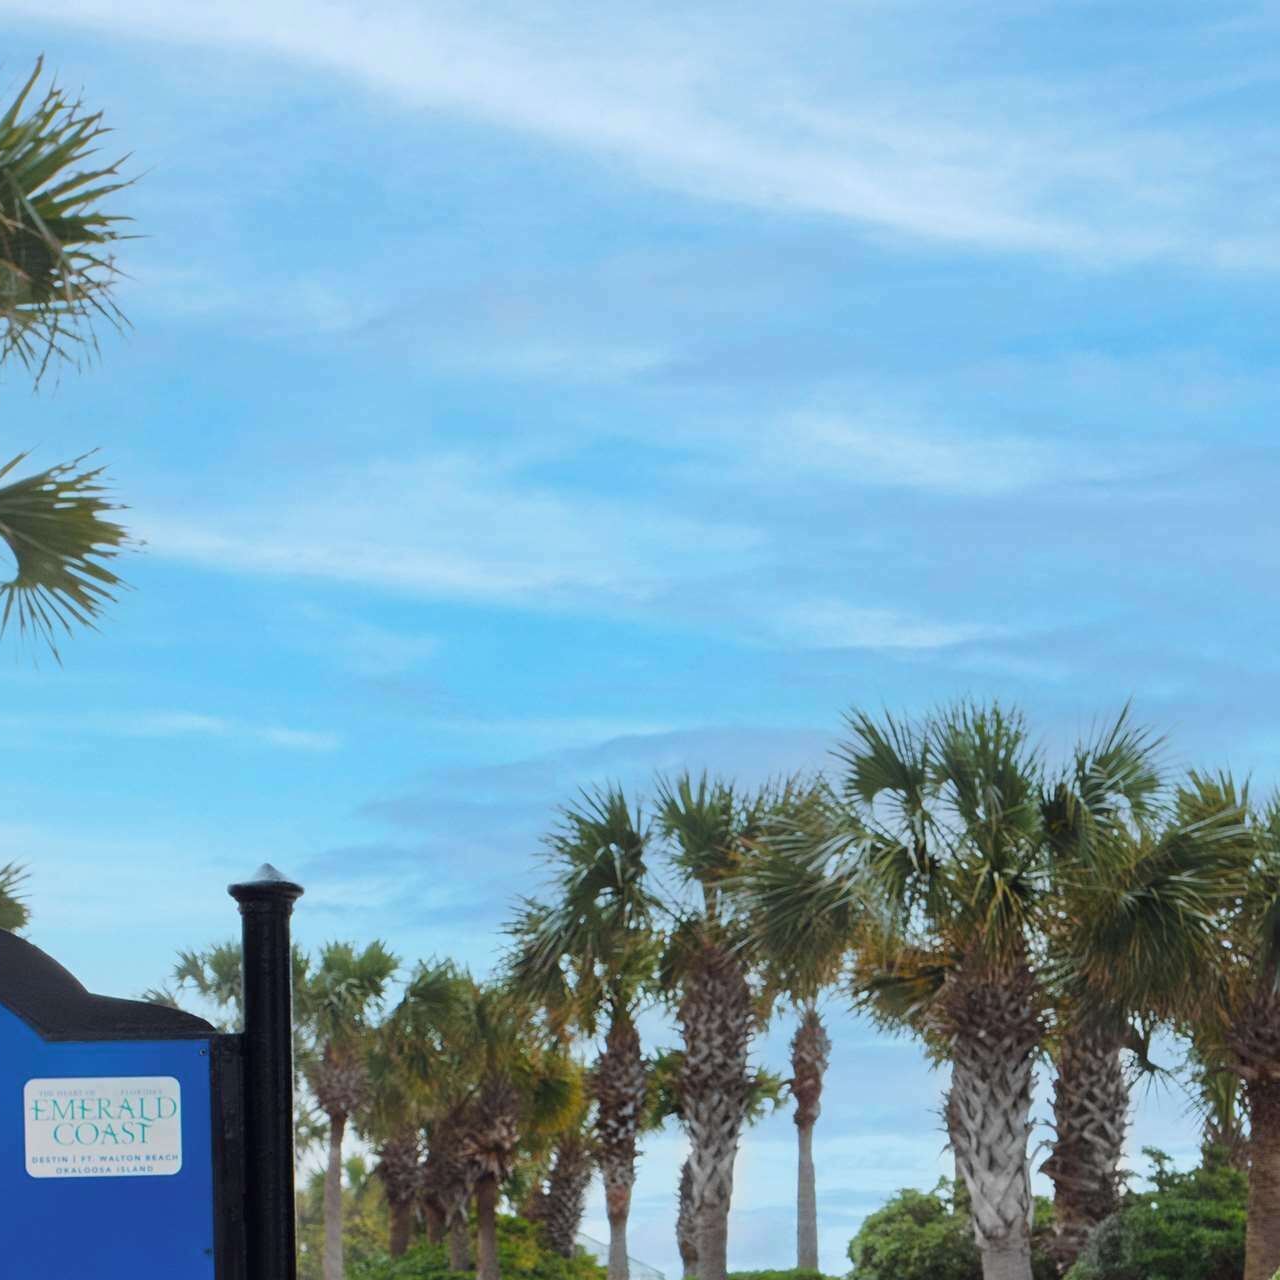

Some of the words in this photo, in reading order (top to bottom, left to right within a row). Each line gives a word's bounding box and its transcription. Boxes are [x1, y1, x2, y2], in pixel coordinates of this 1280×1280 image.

[31, 1096, 177, 1121] EMERALD
[52, 1121, 154, 1146] COAST
[32, 1156, 68, 1164] DESTIN
[99, 1155, 141, 1163] WALTON
[145, 1154, 178, 1162] BEACH
[56, 1166, 112, 1175] OKALOOSA
[116, 1165, 154, 1173] ISLAND
